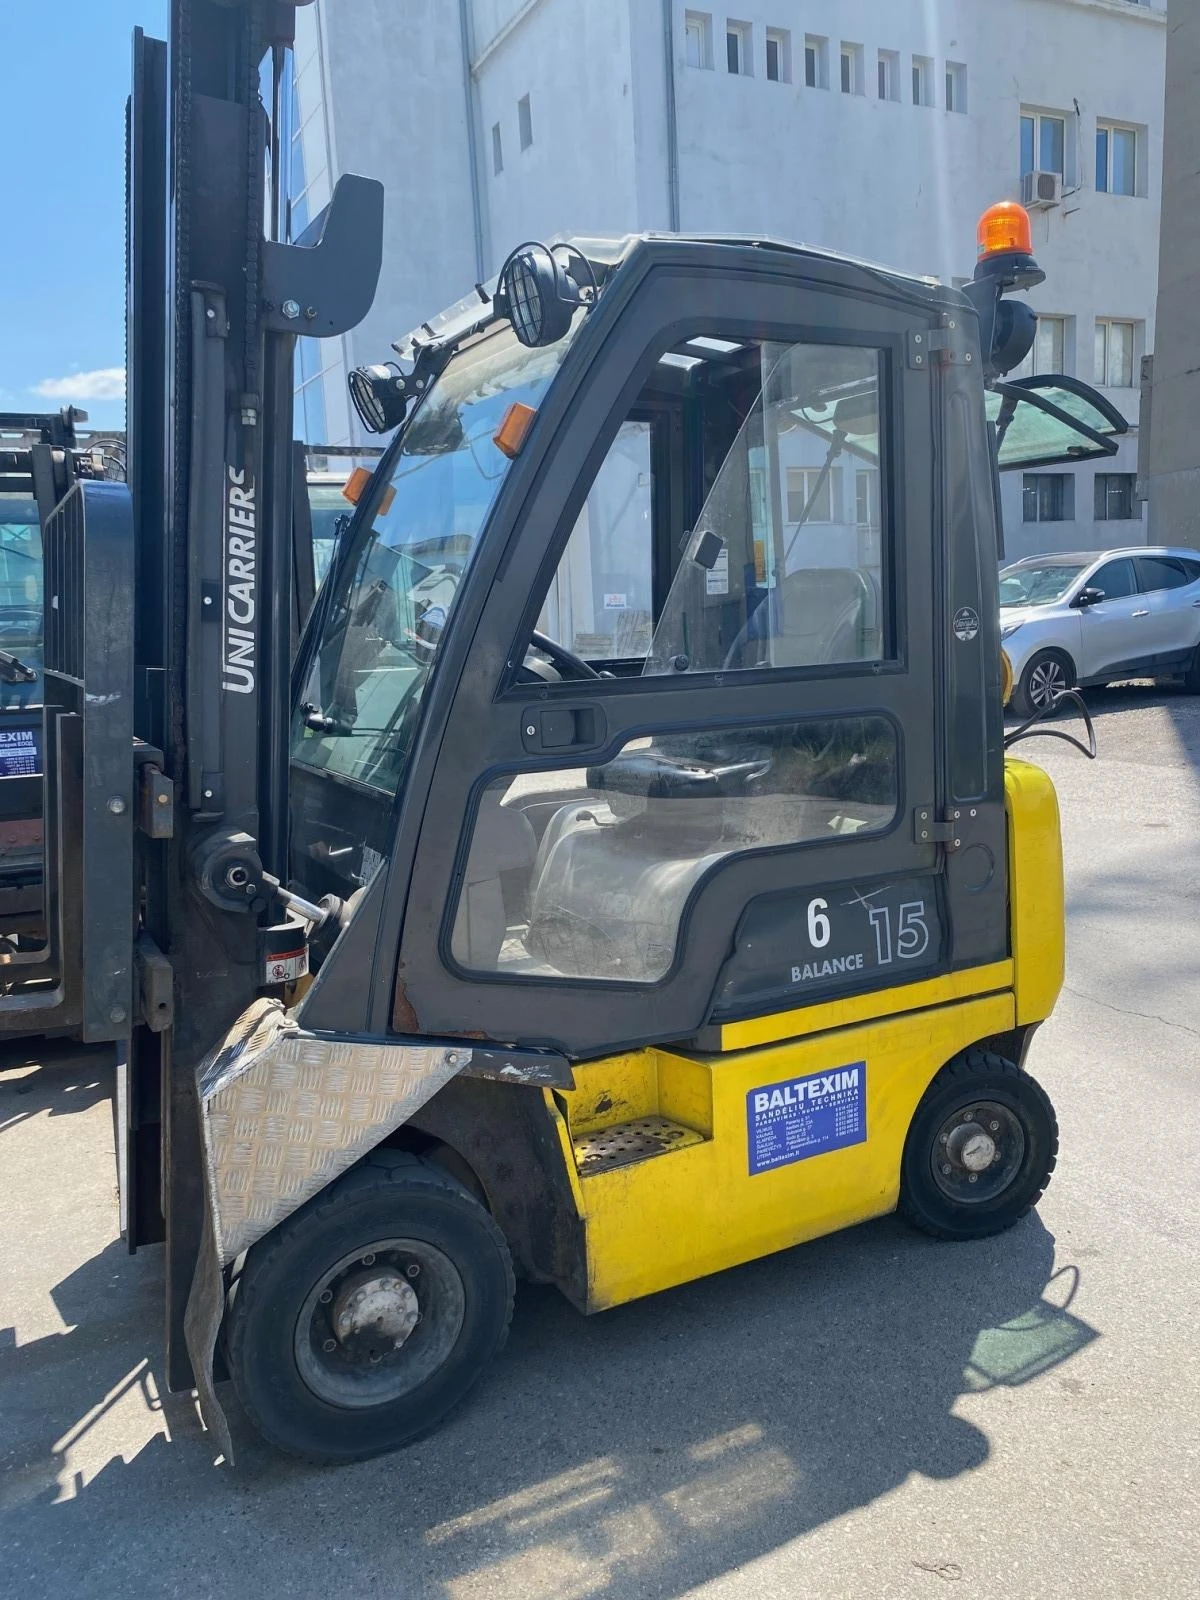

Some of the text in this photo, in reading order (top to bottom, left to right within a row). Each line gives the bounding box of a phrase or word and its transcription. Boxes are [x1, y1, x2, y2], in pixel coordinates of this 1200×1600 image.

[222, 465, 255, 694] UNICARRIERS
[807, 897, 831, 948] 6
[869, 900, 929, 965] 15
[791, 953, 864, 982] BALANCE
[754, 1068, 859, 1113] BALTEXIM
[812, 1088, 859, 1106] TECHNIKA
